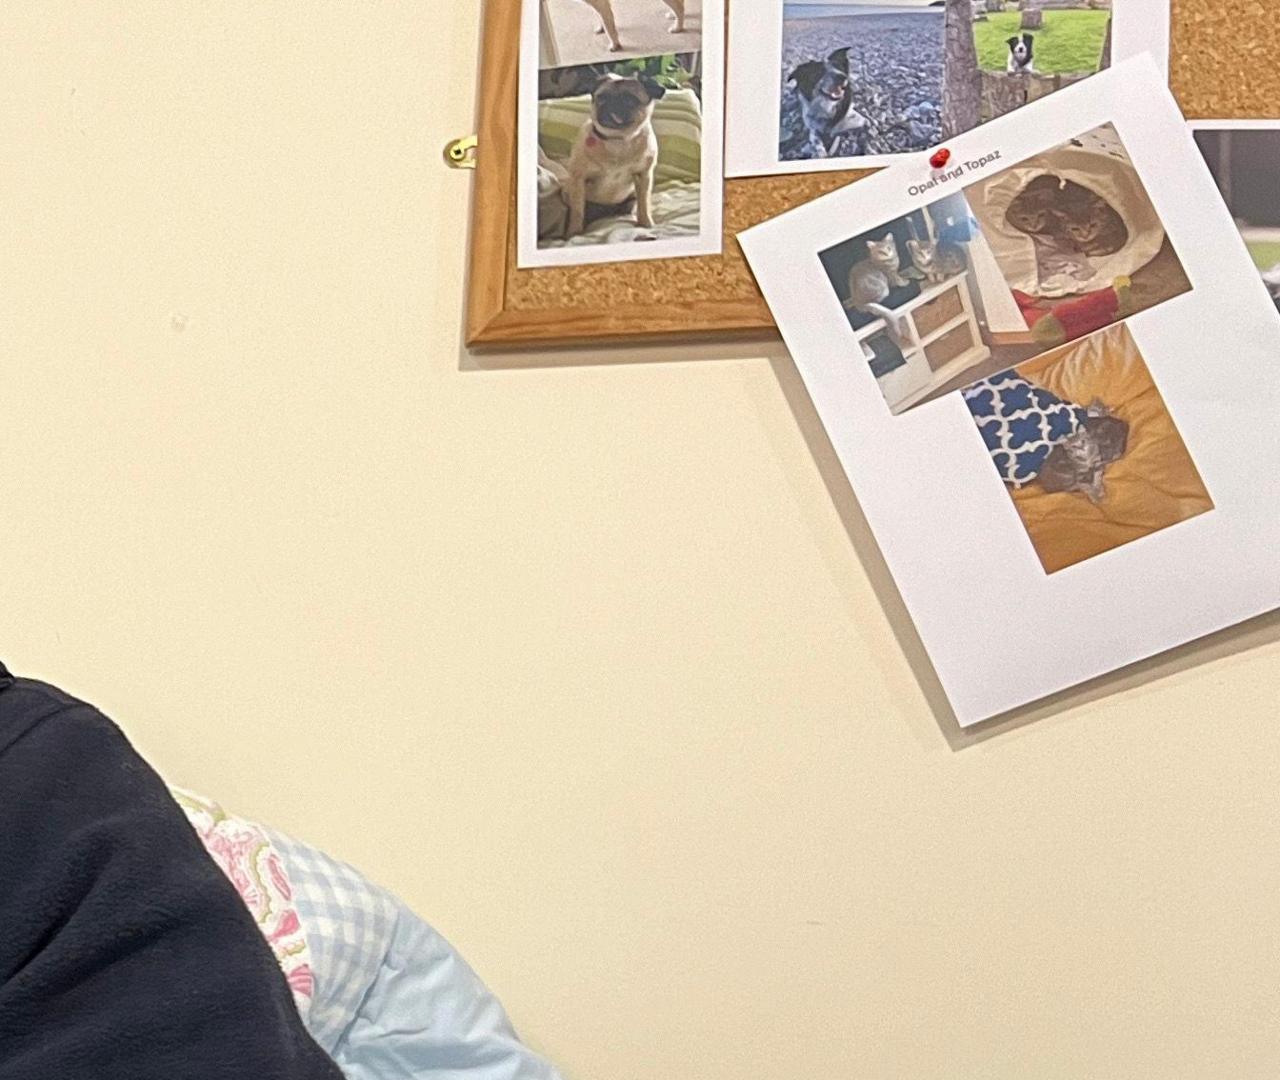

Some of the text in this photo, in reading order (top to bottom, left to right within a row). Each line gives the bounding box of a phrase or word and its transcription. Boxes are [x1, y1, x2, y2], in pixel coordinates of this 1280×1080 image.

[908, 150, 1002, 196] Opal and Topaz
